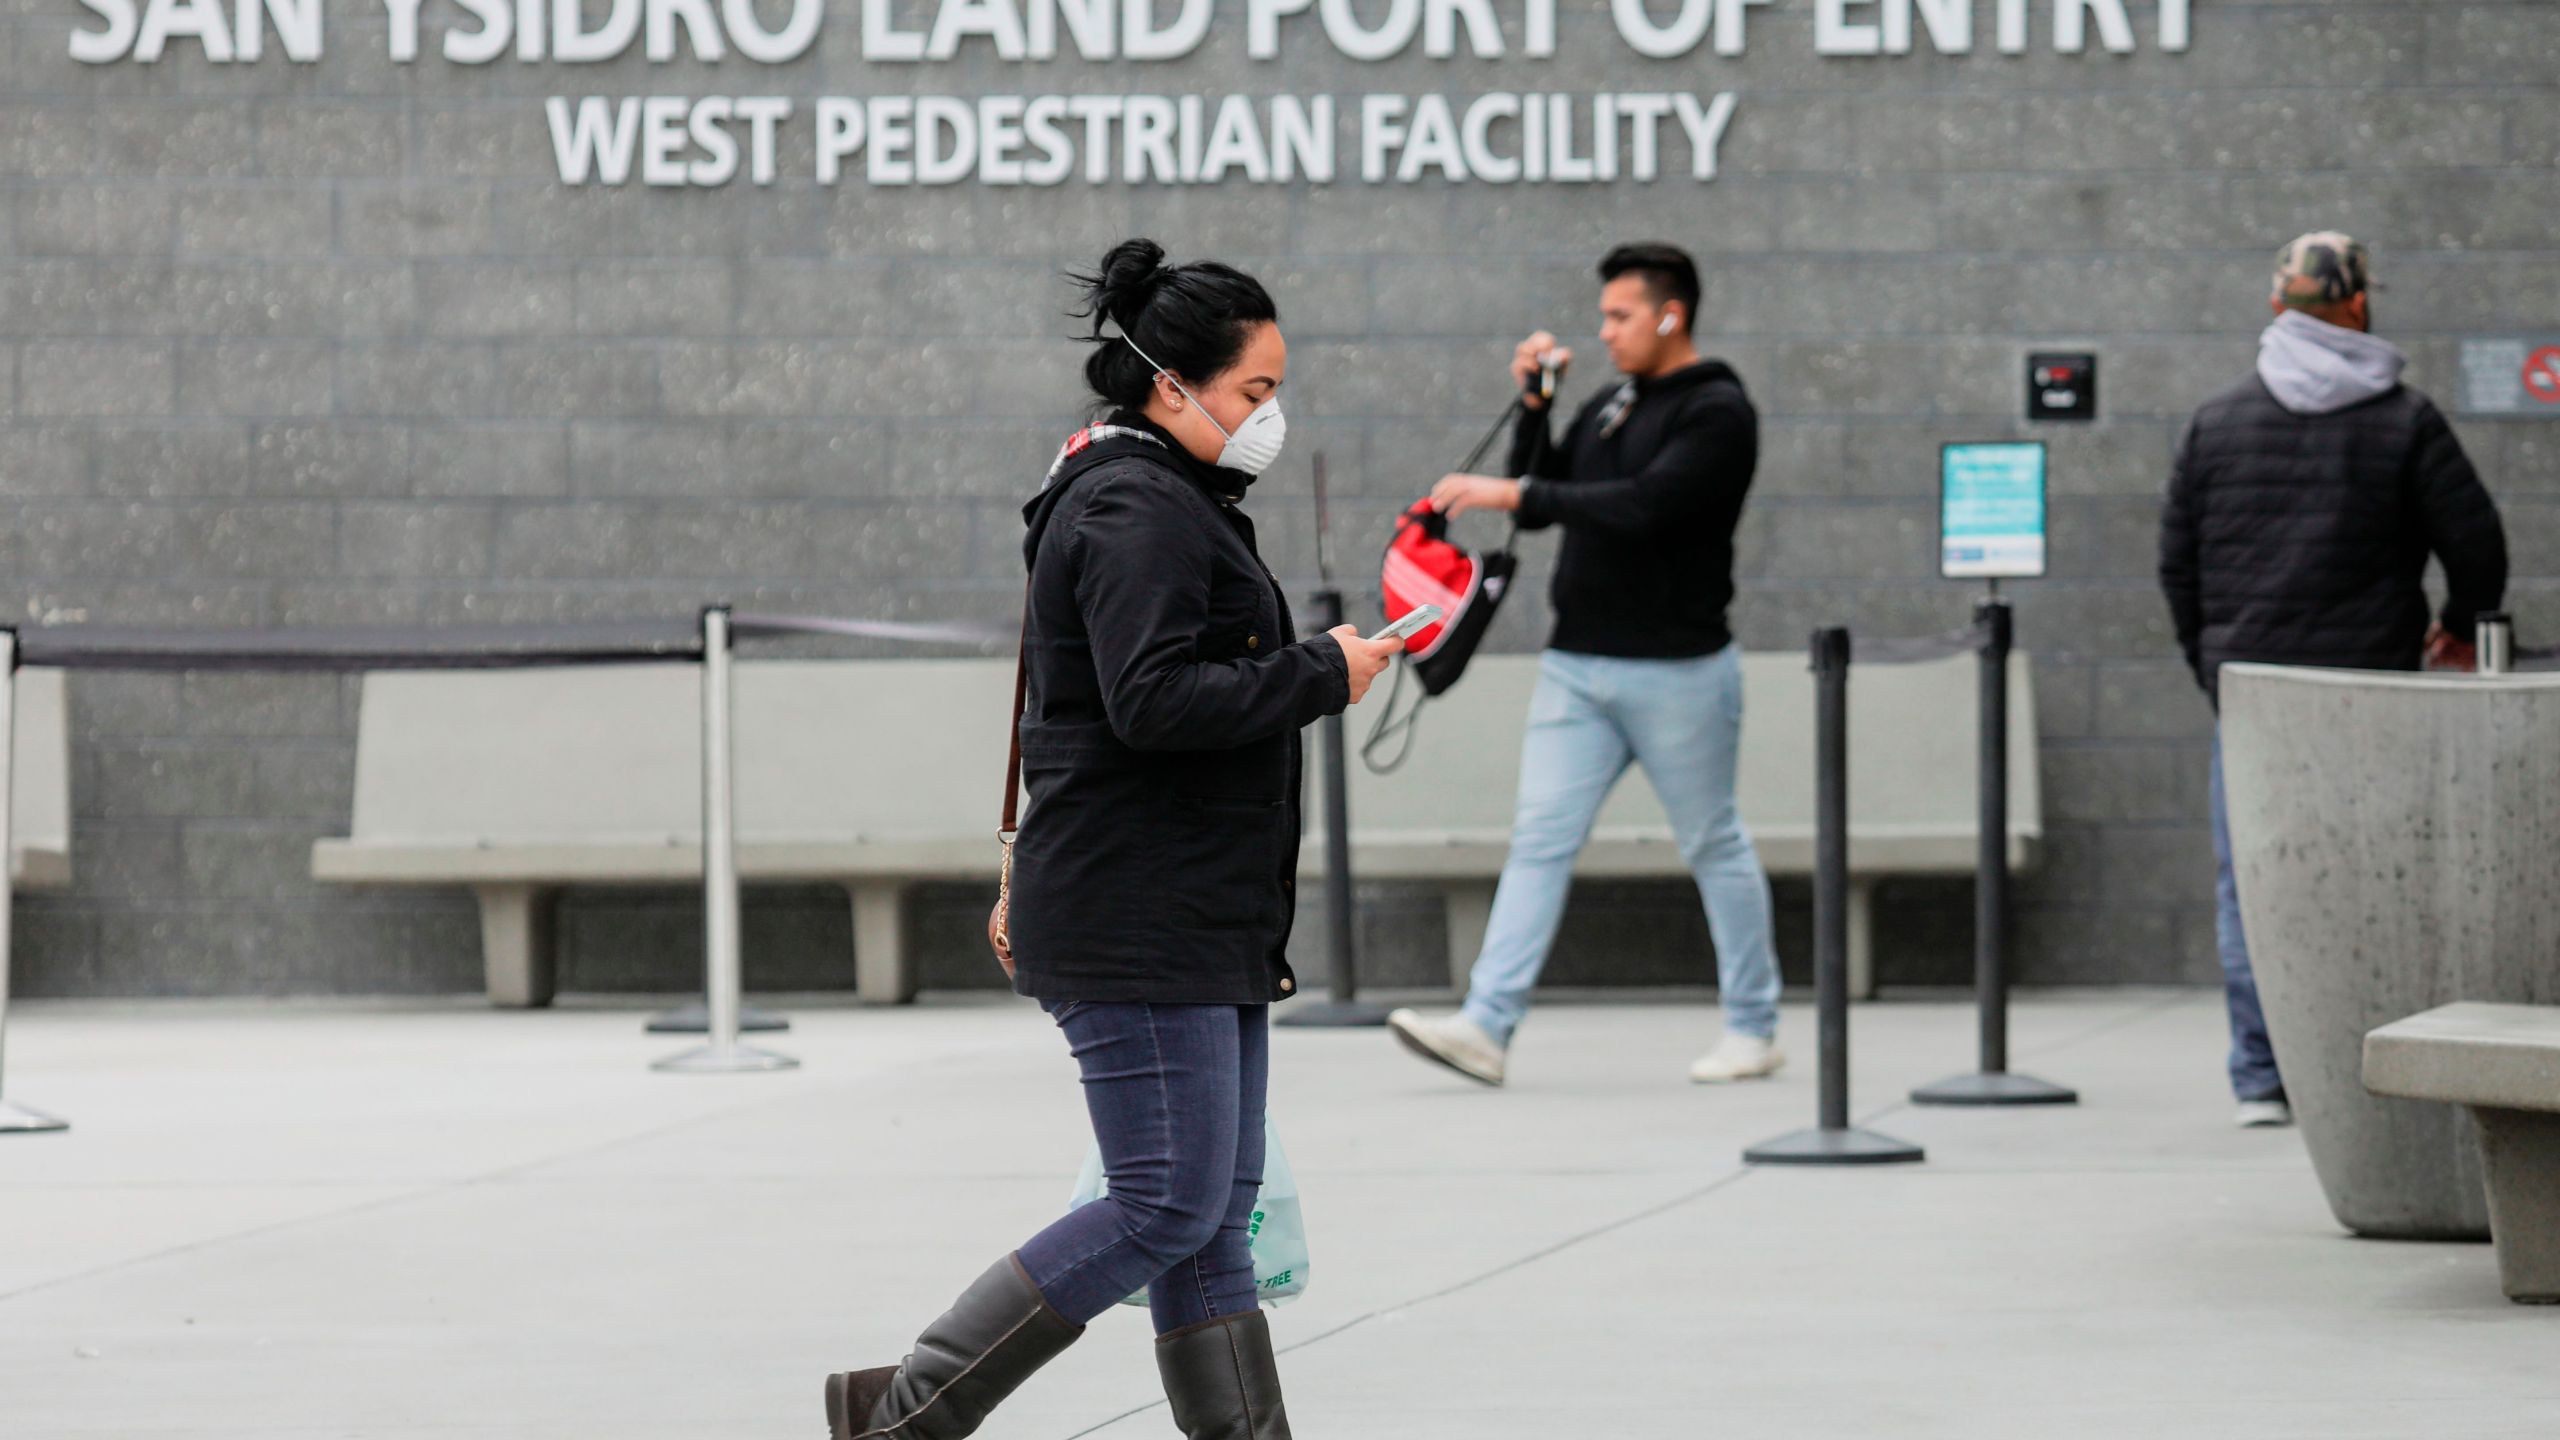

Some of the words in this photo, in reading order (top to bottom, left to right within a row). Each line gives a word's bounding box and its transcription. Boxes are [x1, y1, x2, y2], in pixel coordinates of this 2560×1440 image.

[545, 95, 792, 184] WEST
[814, 94, 1335, 184] PEDESTRIAN
[1361, 92, 1737, 180] FACILITY
[1264, 1270, 1292, 1288] TREE
